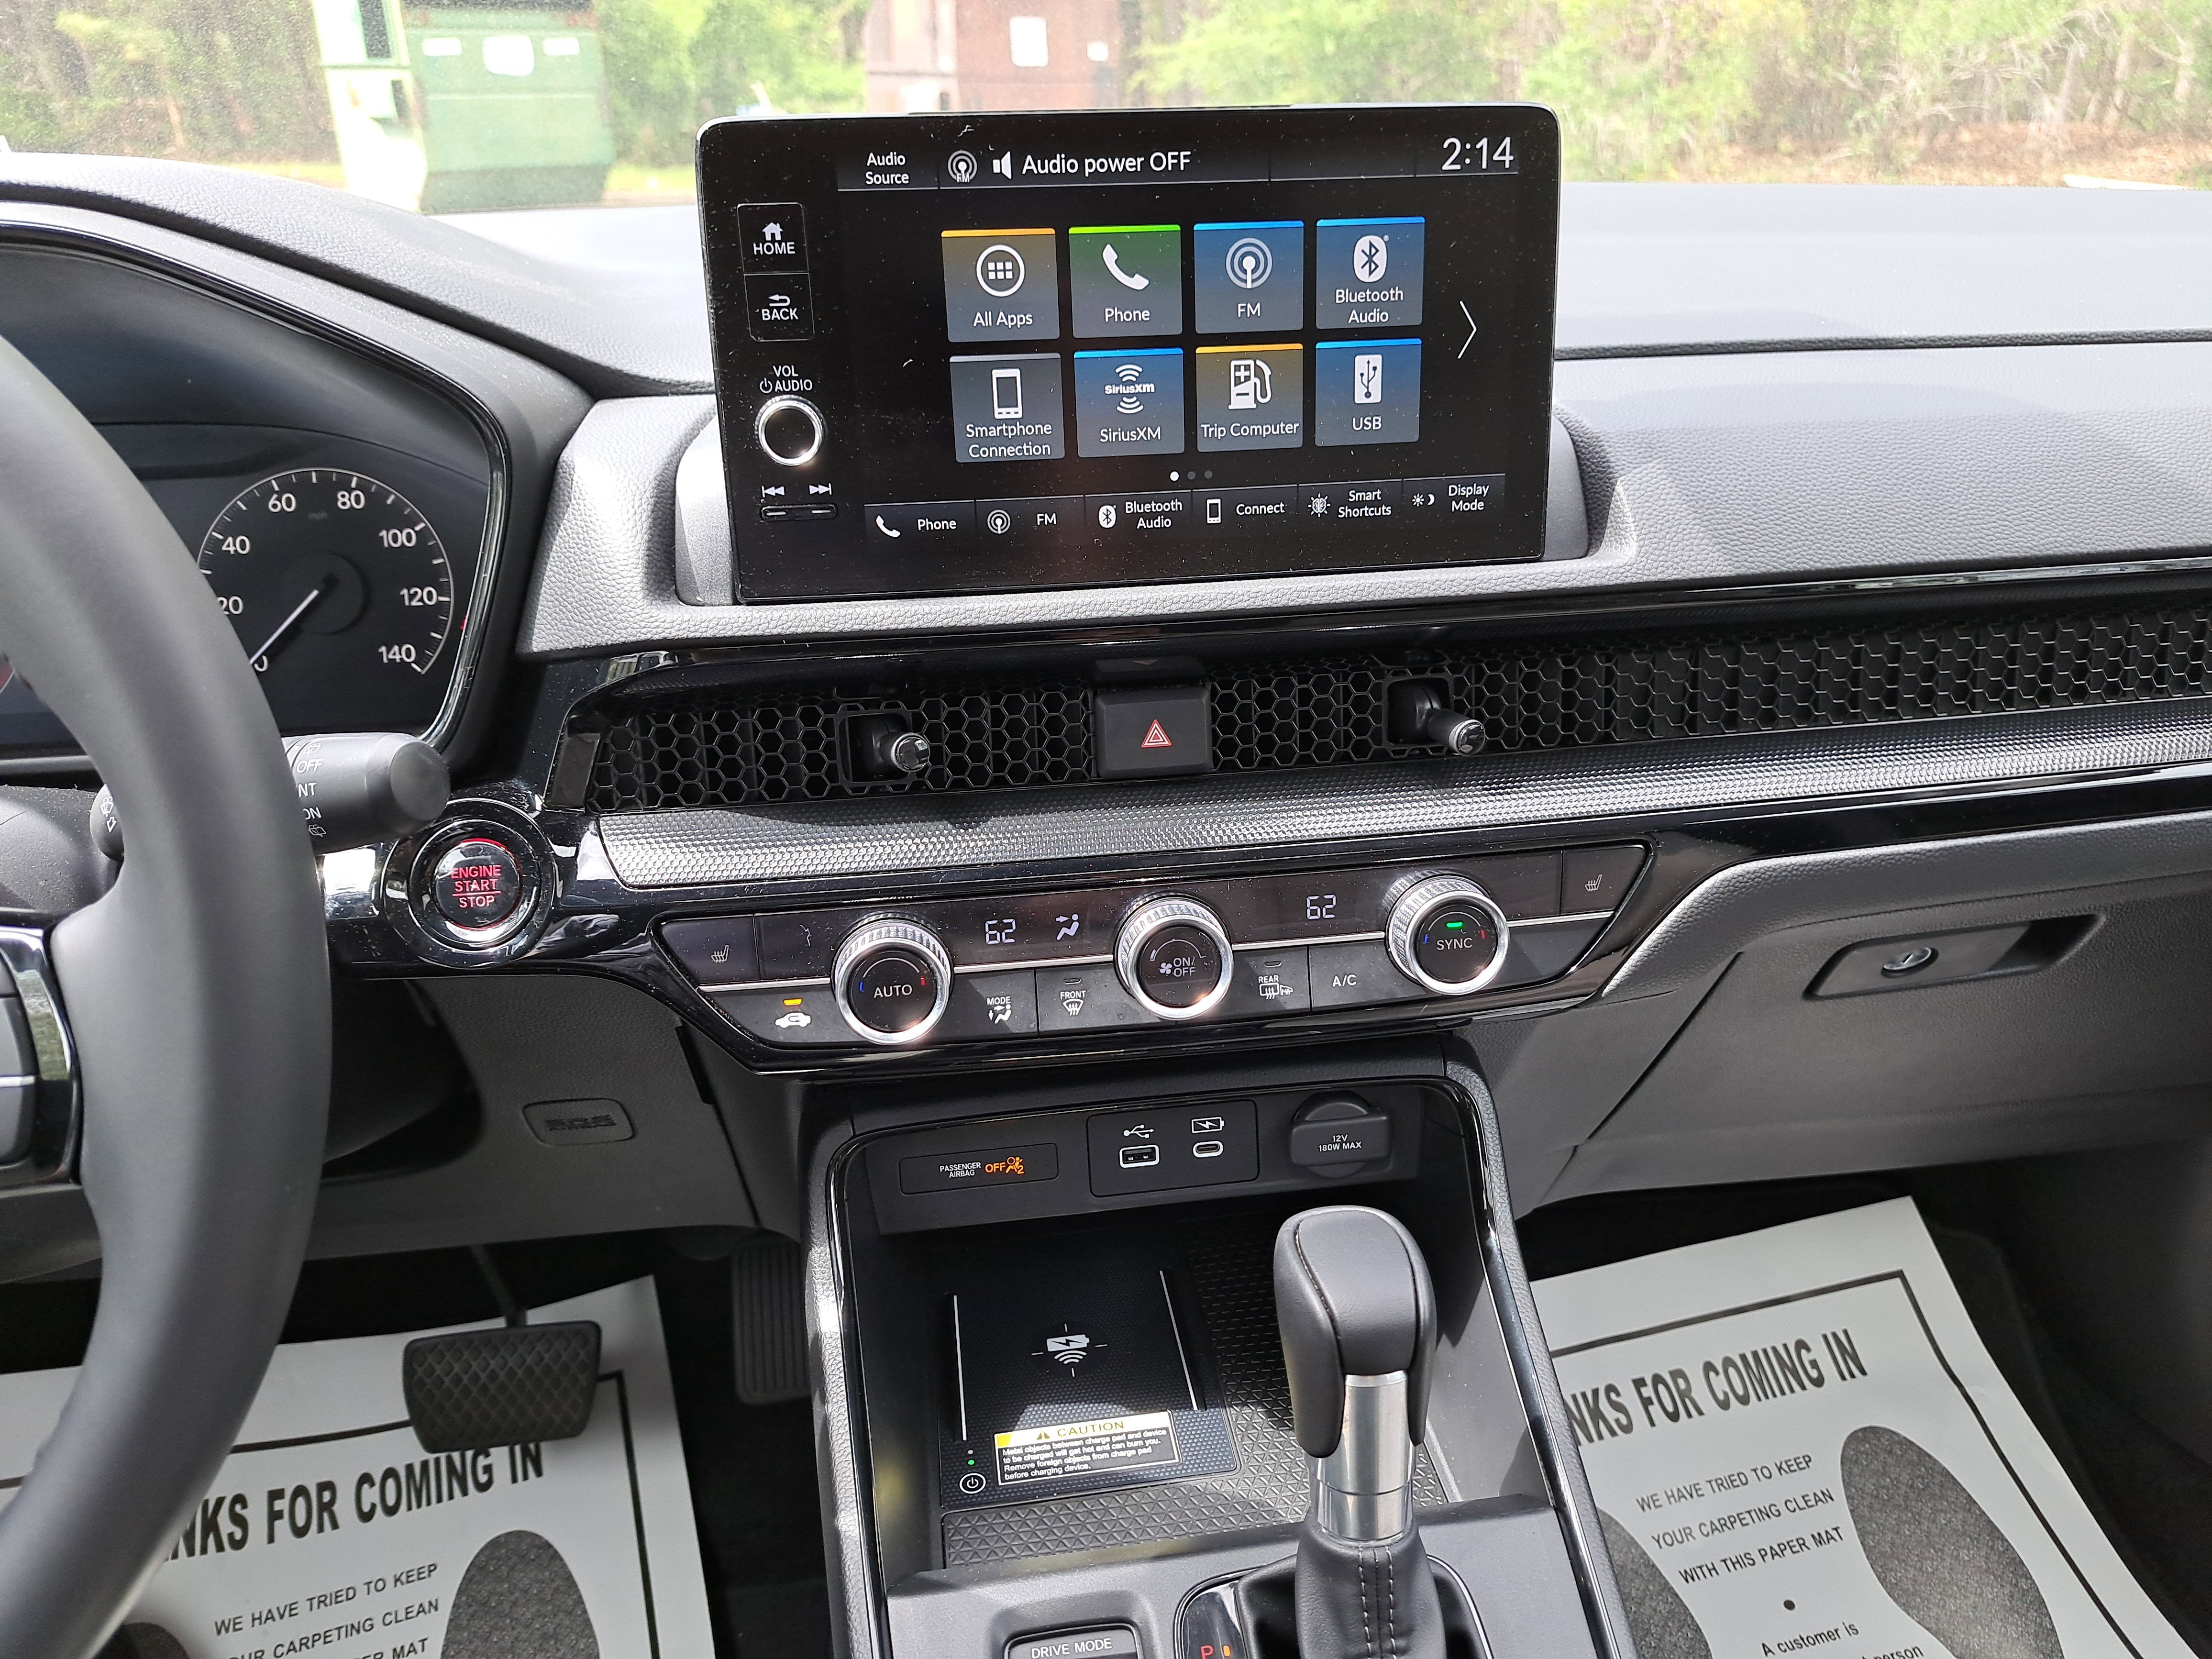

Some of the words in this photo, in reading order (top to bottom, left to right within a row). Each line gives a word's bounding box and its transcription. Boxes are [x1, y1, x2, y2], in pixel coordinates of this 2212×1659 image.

[867, 152, 906, 166] Audio
[1442, 136, 1515, 171] 2:14
[1022, 155, 1078, 174] Audio
[1084, 155, 1145, 178] power
[1150, 151, 1191, 172] OFF
[865, 170, 909, 185] Source
[957, 173, 970, 183] FM
[753, 242, 796, 255] HOME
[1335, 287, 1404, 304] Bluetooth
[762, 307, 799, 321] BACK
[1105, 307, 1150, 323] Phone
[1237, 302, 1261, 318] FM
[1348, 308, 1389, 324] Audio
[973, 311, 993, 327] All
[996, 311, 1033, 328] Apps
[773, 365, 799, 377] VOL
[775, 379, 813, 392] AUDIO
[965, 421, 1052, 438] Smartphone
[1200, 423, 1226, 440] Trip
[1230, 421, 1300, 438] Computer
[1352, 416, 1382, 431] USB
[1100, 426, 1161, 442] SiriusXM
[968, 442, 1051, 458] Connection
[1349, 489, 1382, 501] Smart
[1448, 484, 1490, 498] Display
[268, 493, 297, 512] 60
[337, 490, 365, 509] 80
[1125, 499, 1183, 514] Bluetooth
[1451, 499, 1484, 512] Mode
[1236, 501, 1285, 515] Connect
[1338, 504, 1392, 518] Shortcuts
[917, 517, 957, 531] Phone
[1036, 513, 1057, 527] FM
[1137, 516, 1172, 529] Audio
[222, 535, 250, 555] 40
[379, 529, 417, 548] 100
[400, 586, 437, 606] 120
[217, 596, 243, 615] 20
[378, 644, 416, 664] 140
[297, 758, 324, 773] OFF
[296, 782, 317, 798] NT
[451, 865, 502, 879] ENGINE
[454, 879, 498, 893] START
[459, 896, 495, 908] STOP
[1306, 895, 1337, 920] 62
[984, 918, 1017, 945] 62
[1436, 937, 1473, 951] SYNC
[1173, 966, 1196, 977] OFF
[1258, 974, 1279, 984] REAR
[1332, 973, 1357, 987] A/C
[874, 984, 913, 999] AUTO
[1060, 990, 1086, 1001] FRONT
[986, 995, 1011, 1006] MODE
[1332, 1134, 1348, 1142] 12V
[1319, 1143, 1340, 1152] 180W
[1342, 1141, 1362, 1150] MAX
[940, 1161, 981, 1173] PASSENGER
[949, 1170, 975, 1178] AIRBAG
[984, 1162, 1006, 1173] OFF
[1563, 1383, 1634, 1446] NKS
[1632, 1367, 1705, 1427] FOR
[1702, 1338, 1825, 1410] COMING
[1821, 1328, 1868, 1382] IN
[1057, 1421, 1124, 1437] CAUTION
[1002, 1447, 1023, 1456] Metal
[1024, 1444, 1051, 1453] objects
[1052, 1439, 1084, 1449] between
[1085, 1437, 1110, 1445] charge
[1112, 1433, 1126, 1442] pad
[1127, 1431, 1142, 1439] and
[1142, 1429, 1167, 1438] device
[1023, 1451, 1054, 1461] charged
[1055, 1449, 1068, 1457] will
[1068, 1448, 1082, 1457] get
[1082, 1445, 1095, 1453] hot
[1095, 1443, 1110, 1451] and
[1126, 1440, 1144, 1448] burn
[1144, 1438, 1161, 1447] you.
[1004, 1462, 1035, 1472] Remove
[1037, 1459, 1063, 1467] foreign
[1064, 1454, 1091, 1464] objects
[1110, 1449, 1137, 1458] charge
[1137, 1446, 1152, 1457] pad
[1004, 1471, 1029, 1480] before
[1030, 1466, 1063, 1476] charging
[1064, 1462, 1092, 1472] device.
[1636, 1493, 1663, 1513] WE
[1664, 1482, 1705, 1505] HAVE
[1706, 1471, 1748, 1494] TRIED
[1750, 1465, 1773, 1482] TO
[1774, 1454, 1813, 1476] KEEP
[164, 1493, 249, 1562] NKS
[265, 1479, 340, 1545] FOR
[354, 1449, 495, 1524] COMING
[508, 1442, 545, 1485] IN
[1651, 1526, 1697, 1550] YOUR
[1698, 1503, 1782, 1537] CARPETING
[1784, 1488, 1835, 1514] CLEAN
[1679, 1561, 1720, 1584] WITH
[1720, 1552, 1756, 1573] THIS
[1758, 1537, 1812, 1563] PAPER
[1811, 1526, 1845, 1548] MAT
[214, 1615, 243, 1637] WE
[250, 1601, 300, 1628] HAVE
[305, 1586, 357, 1613] TRIED
[362, 1577, 387, 1596] TO
[393, 1562, 438, 1589] KEEP
[230, 1649, 265, 1659] UR
[273, 1617, 375, 1659] CARPETING
[381, 1597, 440, 1627] CLEAN
[1760, 1642, 1775, 1658] A
[1777, 1626, 1842, 1654] customer
[1842, 1621, 1860, 1637] is
[392, 1637, 428, 1659] MAT
[1030, 1641, 1071, 1659] DRIVE
[1074, 1637, 1113, 1654] MODE
[1200, 1645, 1214, 1659] P
